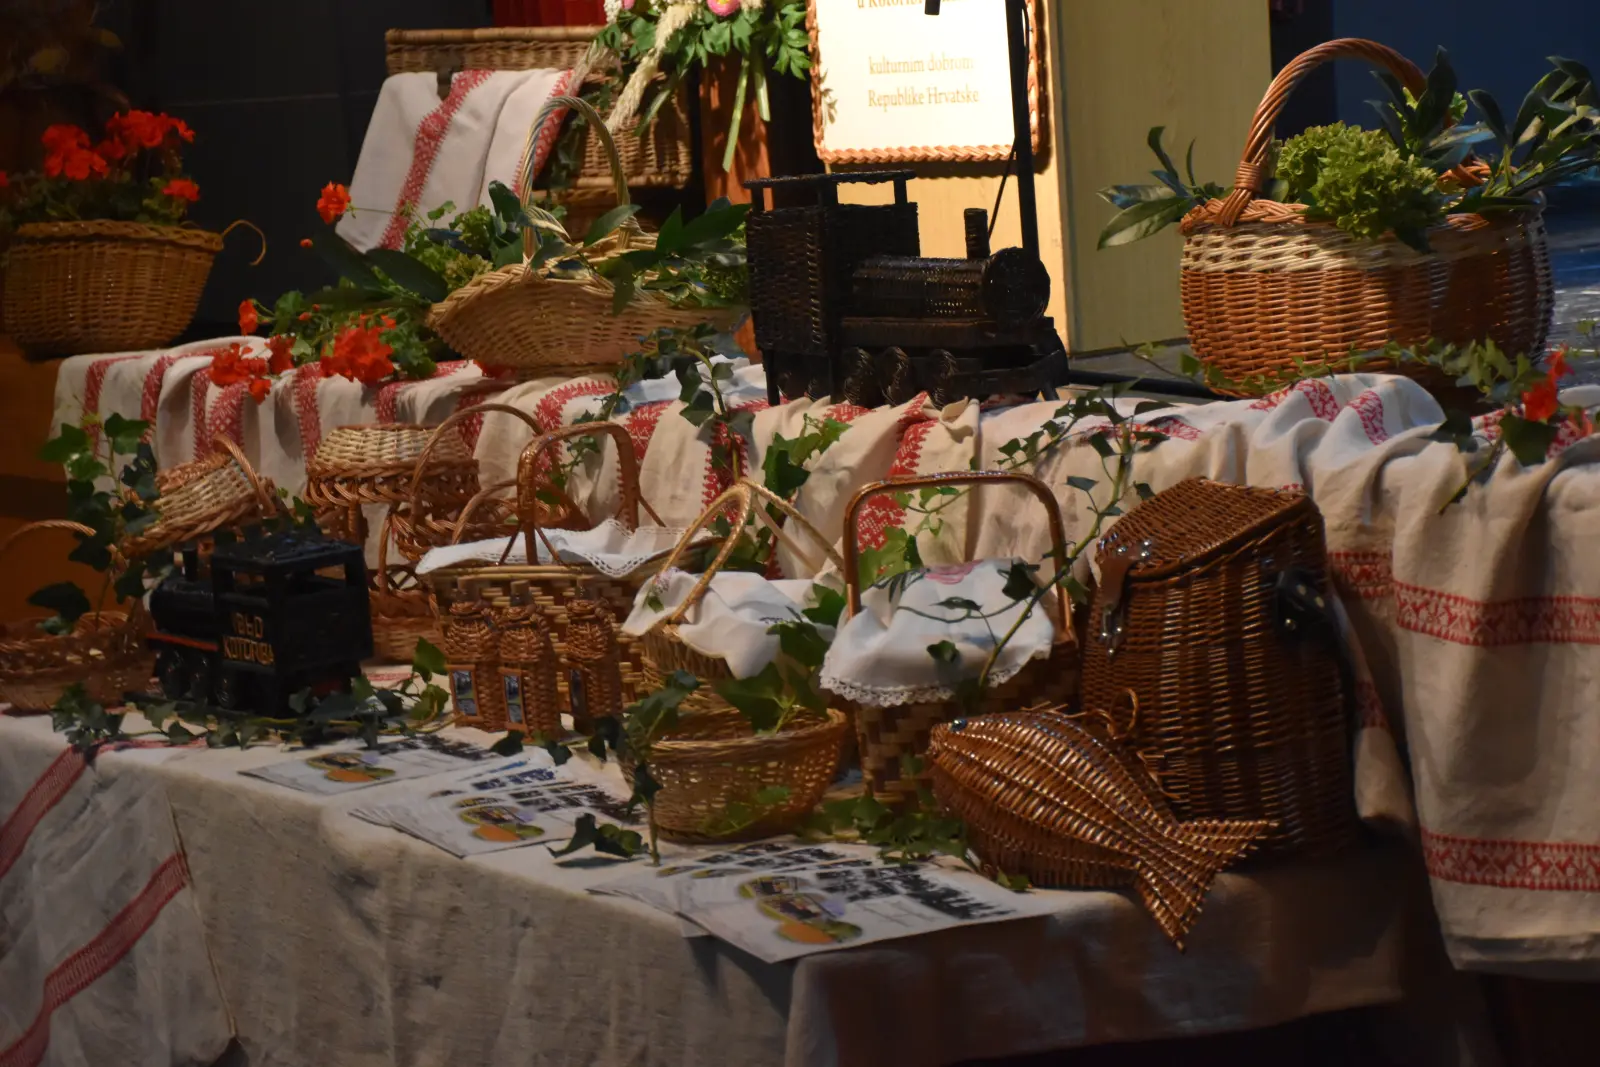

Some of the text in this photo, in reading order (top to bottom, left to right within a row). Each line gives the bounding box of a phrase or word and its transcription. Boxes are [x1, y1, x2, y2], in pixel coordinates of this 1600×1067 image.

[868, 51, 974, 75] kulturnim dobrom
[868, 83, 979, 112] Republike Hrvatske
